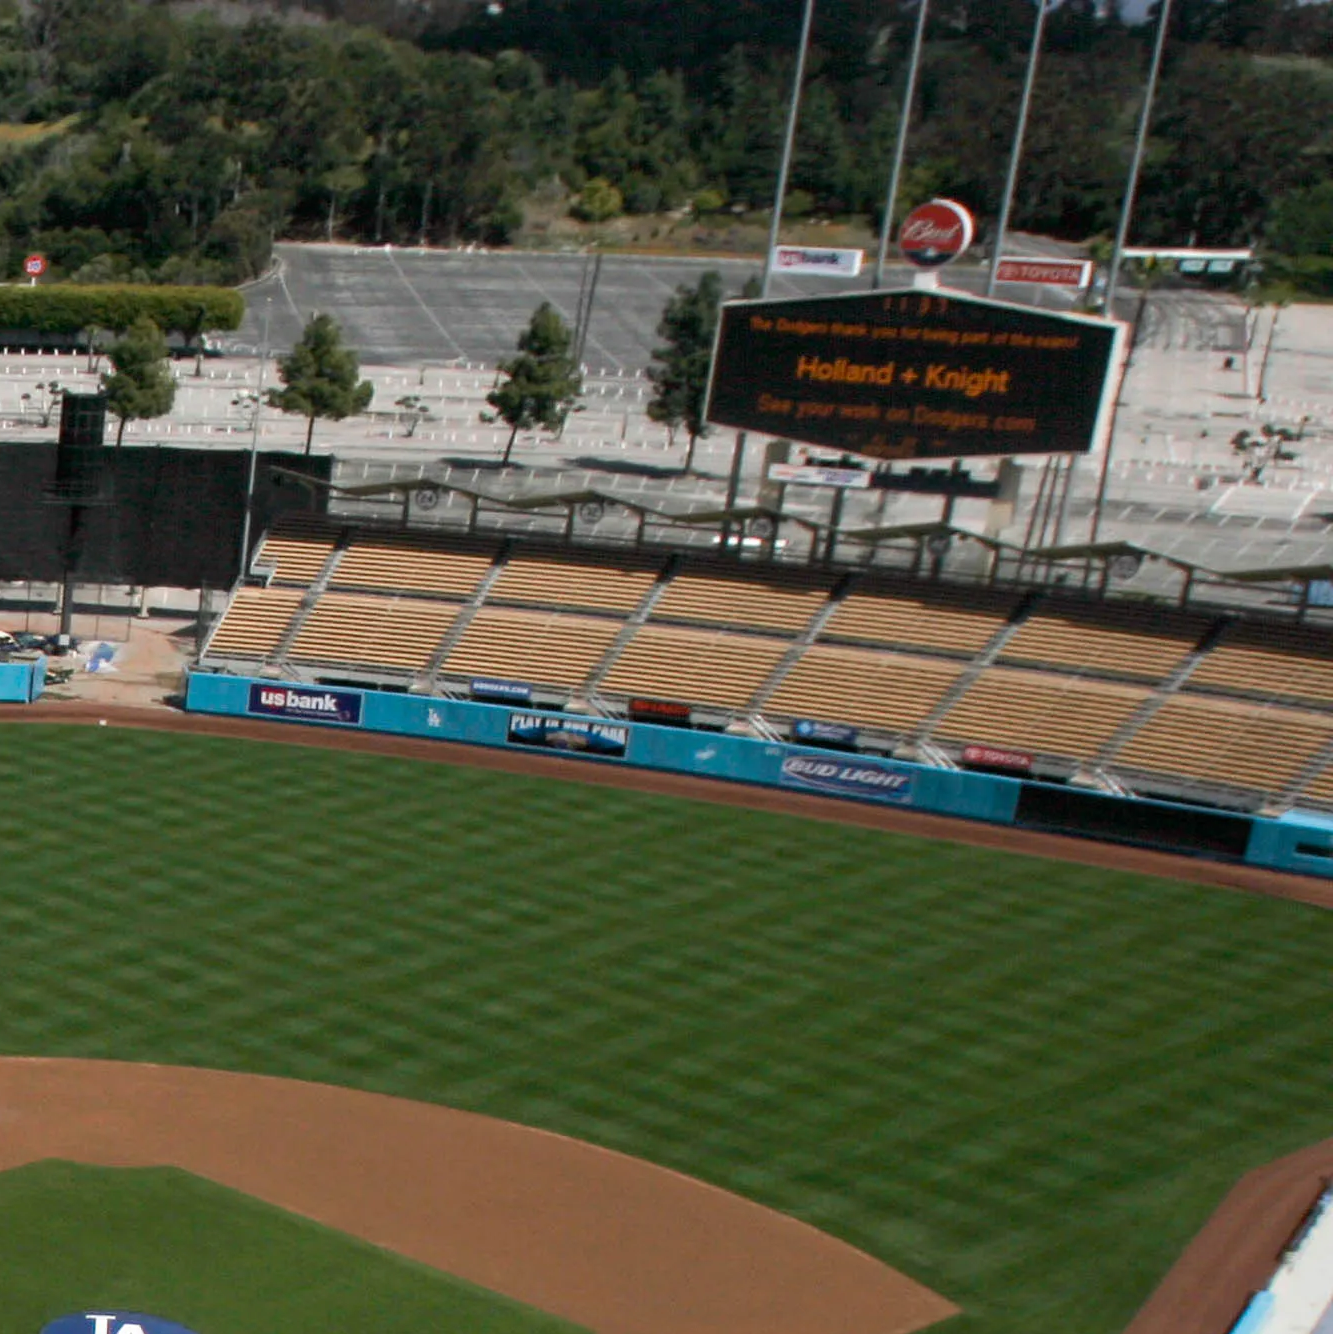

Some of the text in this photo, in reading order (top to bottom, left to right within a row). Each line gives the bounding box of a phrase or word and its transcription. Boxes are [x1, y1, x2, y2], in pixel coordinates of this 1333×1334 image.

[1020, 265, 1079, 282] TOYOTA
[796, 355, 1010, 396] Holland + Knight
[984, 750, 1030, 765] TOYOTA
[788, 759, 908, 789] BUD LIGHT
